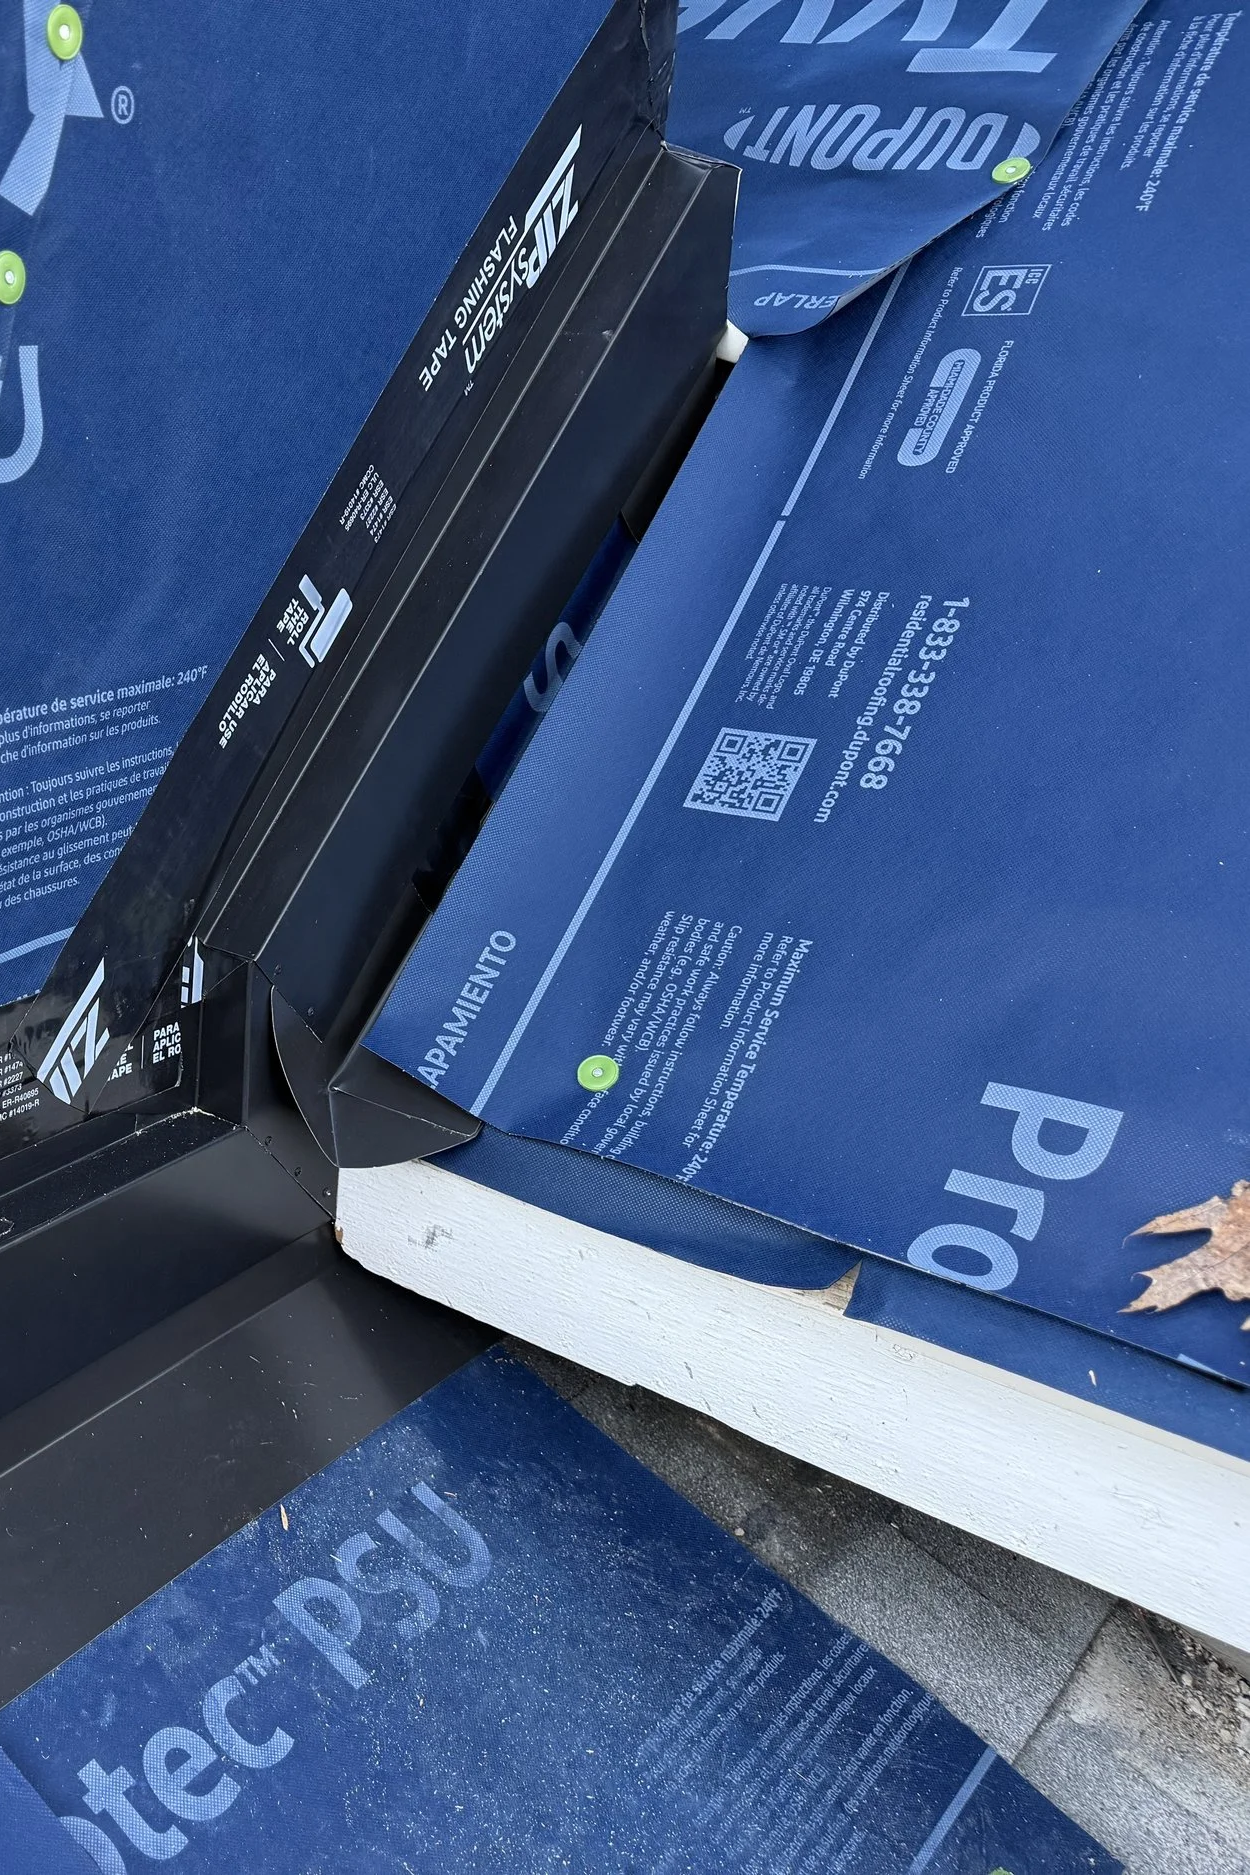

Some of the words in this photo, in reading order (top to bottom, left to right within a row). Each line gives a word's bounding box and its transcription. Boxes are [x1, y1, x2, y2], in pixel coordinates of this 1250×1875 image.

[1194, 72, 1210, 86] de
[1176, 88, 1202, 124] service
[744, 104, 1011, 171] DUPONT
[1150, 126, 1184, 178] maximale:
[1136, 180, 1160, 212] 240°F
[454, 216, 518, 328] FLASHING
[946, 266, 964, 288] Refer
[972, 268, 1030, 312] ES
[928, 298, 950, 330] Product
[419, 328, 457, 391] TAPE
[906, 330, 934, 374] Information
[988, 340, 1014, 378] FLORIDA
[890, 400, 902, 412] for
[896, 376, 914, 398] Sheet
[970, 380, 996, 424] PRODUCT
[880, 412, 894, 434] more
[914, 388, 938, 426] APPROVED
[912, 414, 938, 454] COUNTY
[946, 424, 976, 474] APPROVED
[858, 434, 886, 480] information
[276, 597, 299, 633] TAPE
[814, 588, 856, 646] Wilmington,
[854, 592, 890, 644] Distributed
[856, 590, 872, 608] 974
[286, 606, 304, 635] THE
[287, 611, 309, 645] ROLL
[838, 610, 862, 640] Centre
[252, 653, 266, 670] EL
[808, 648, 824, 664] DE
[824, 642, 846, 666] Road
[846, 646, 862, 658] by
[50, 698, 68, 712] de
[70, 688, 114, 710] service
[116, 674, 176, 700] maximale:
[176, 664, 208, 686] 240°F
[236, 661, 270, 720] APLICAR
[252, 669, 276, 705] PARA
[794, 666, 816, 696] 19805
[828, 660, 856, 698] DuPont
[859, 596, 970, 790] 1-833-338-7668
[22, 714, 98, 740] d'informations,
[100, 710, 110, 722] se
[112, 700, 152, 718] reporter
[218, 673, 253, 731] RODILLO
[813, 594, 933, 823] residentialroofing.dupont.com
[20, 734, 88, 758] d'information
[90, 728, 104, 742] sur
[106, 726, 120, 736] les
[120, 714, 160, 736] produits.
[218, 717, 238, 749] USE
[30, 774, 74, 794] Toujours
[74, 766, 104, 782] suivre
[106, 760, 120, 774] les
[122, 746, 174, 768] instructions,
[4, 894, 22, 908] des
[24, 876, 80, 900] chaussures.
[752, 932, 774, 962] more
[772, 936, 794, 966] Refer
[764, 968, 778, 980] to
[770, 938, 814, 1006] Maximum
[417, 930, 517, 1090] APAMIENTO
[718, 962, 762, 1030] information.
[740, 980, 772, 1026] Product
[153, 1022, 180, 1041] PARA
[744, 1008, 780, 1060] Service
[111, 1064, 133, 1081] APE
[153, 1052, 165, 1064] EL
[710, 1028, 750, 1096] Information
[4, 1071, 23, 1085] #2227
[8, 1098, 39, 1116] #14019-R
[690, 1098, 718, 1130] Sheet
[698, 1064, 756, 1154] Temperature:
[682, 1132, 700, 1148] for
[907, 1081, 1124, 1291] Pro
[273, 1480, 493, 1689] PSU
